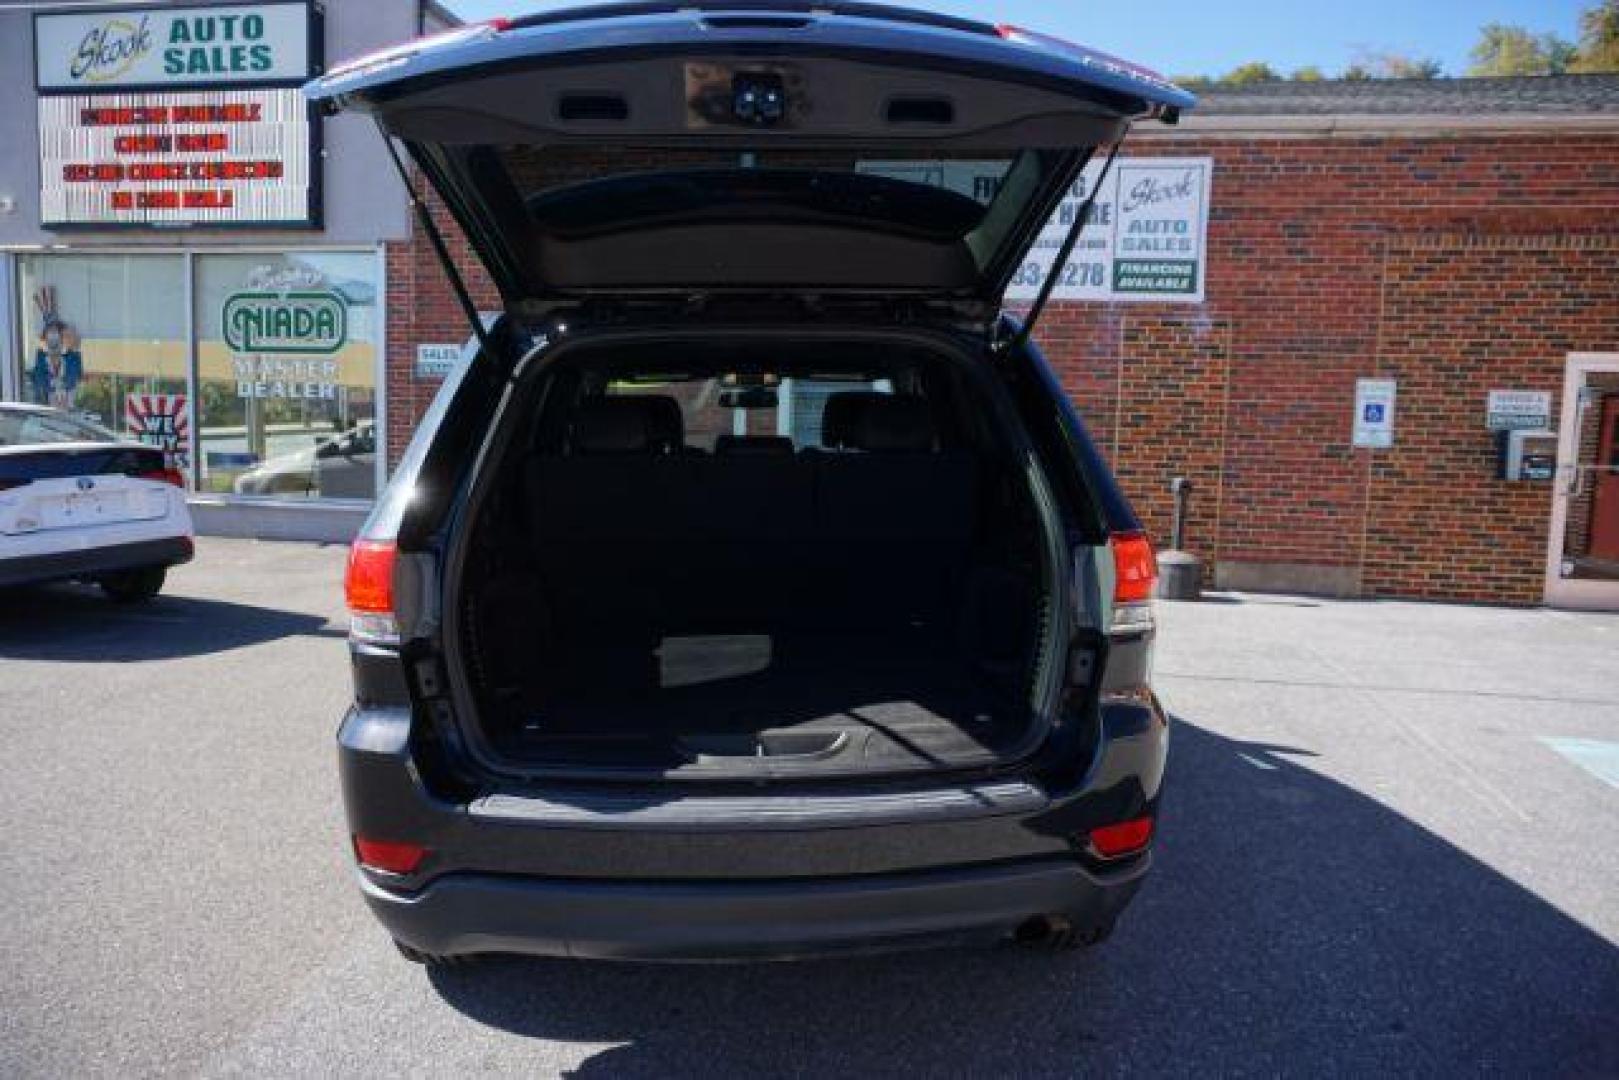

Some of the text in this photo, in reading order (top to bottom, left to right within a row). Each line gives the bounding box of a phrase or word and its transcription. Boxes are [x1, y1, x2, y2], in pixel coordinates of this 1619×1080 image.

[169, 15, 263, 43] AUTO
[164, 44, 272, 74] SALES
[1060, 202, 1111, 225] HRE
[1128, 220, 1187, 233] AUTO
[1122, 238, 1192, 251] SALES
[1119, 263, 1192, 275] FINANCING
[1119, 277, 1191, 290] AVAILABLE
[232, 306, 335, 339] NIADA
[422, 348, 458, 360] SALES
[235, 361, 336, 380] MASTER
[237, 381, 335, 398] DEALER
[144, 416, 173, 432] WE
